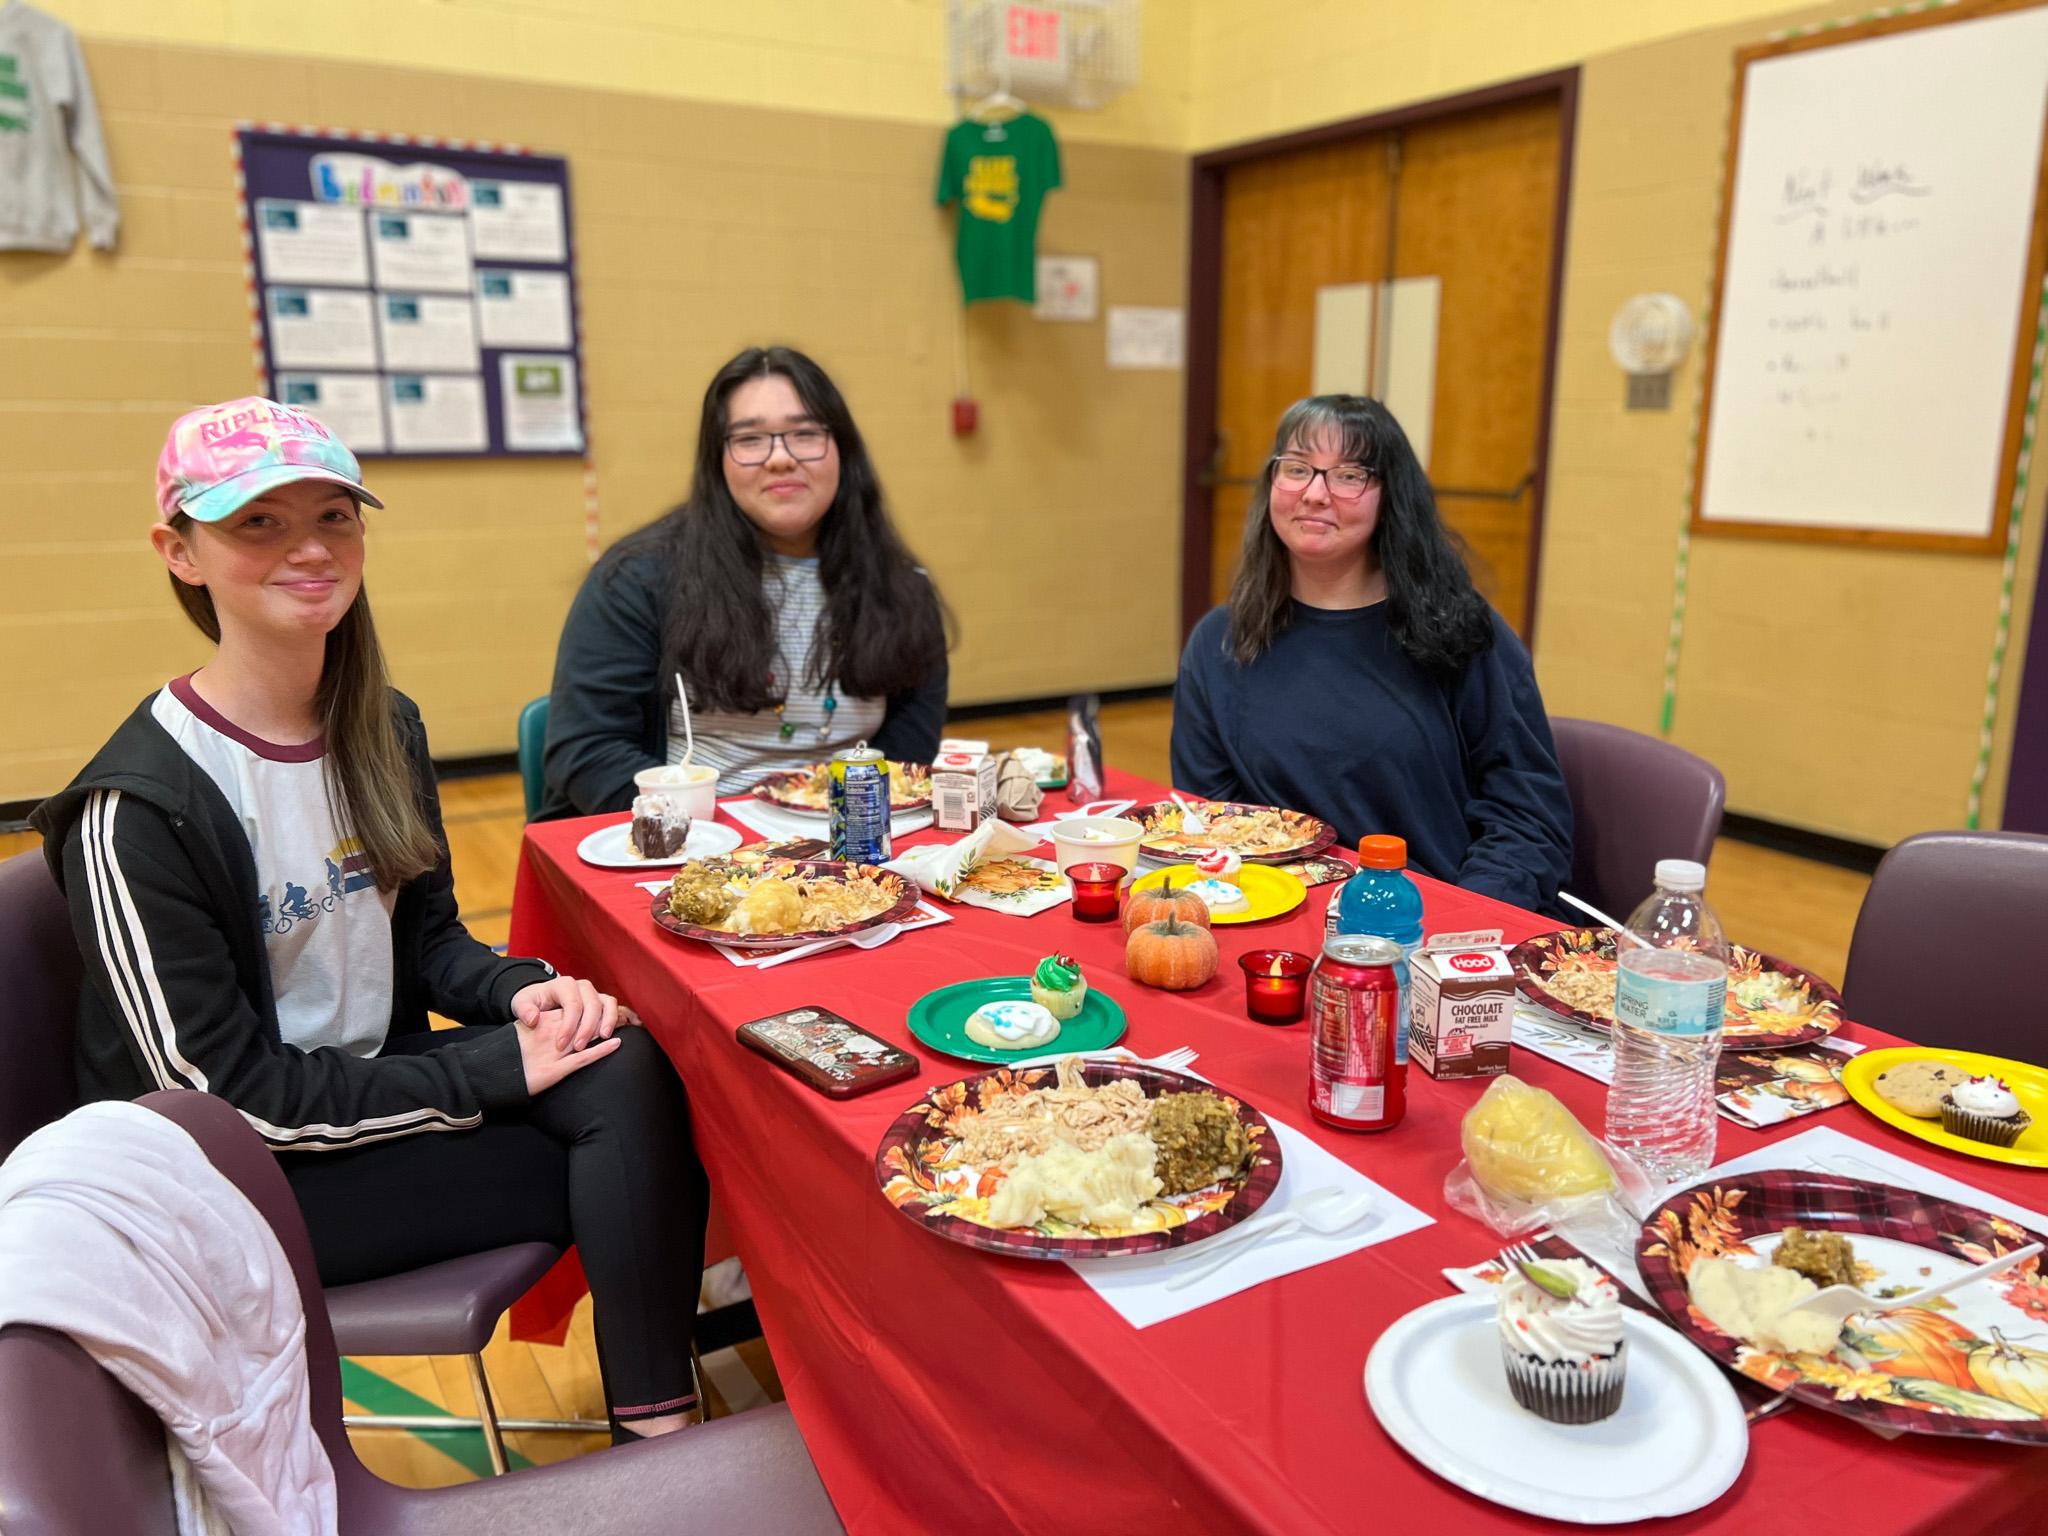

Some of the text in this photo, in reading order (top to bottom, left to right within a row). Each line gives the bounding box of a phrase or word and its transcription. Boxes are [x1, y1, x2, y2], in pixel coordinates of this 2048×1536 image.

[1007, 6, 1060, 61] EXIT
[1453, 956, 1492, 969] Hood
[1620, 992, 1649, 1011] SPRING
[1451, 1003, 1504, 1017] CHOCOLATE
[1620, 1002, 1646, 1019] WATER
[1467, 1016, 1482, 1024] FREE
[1483, 1015, 1499, 1023] MILK
